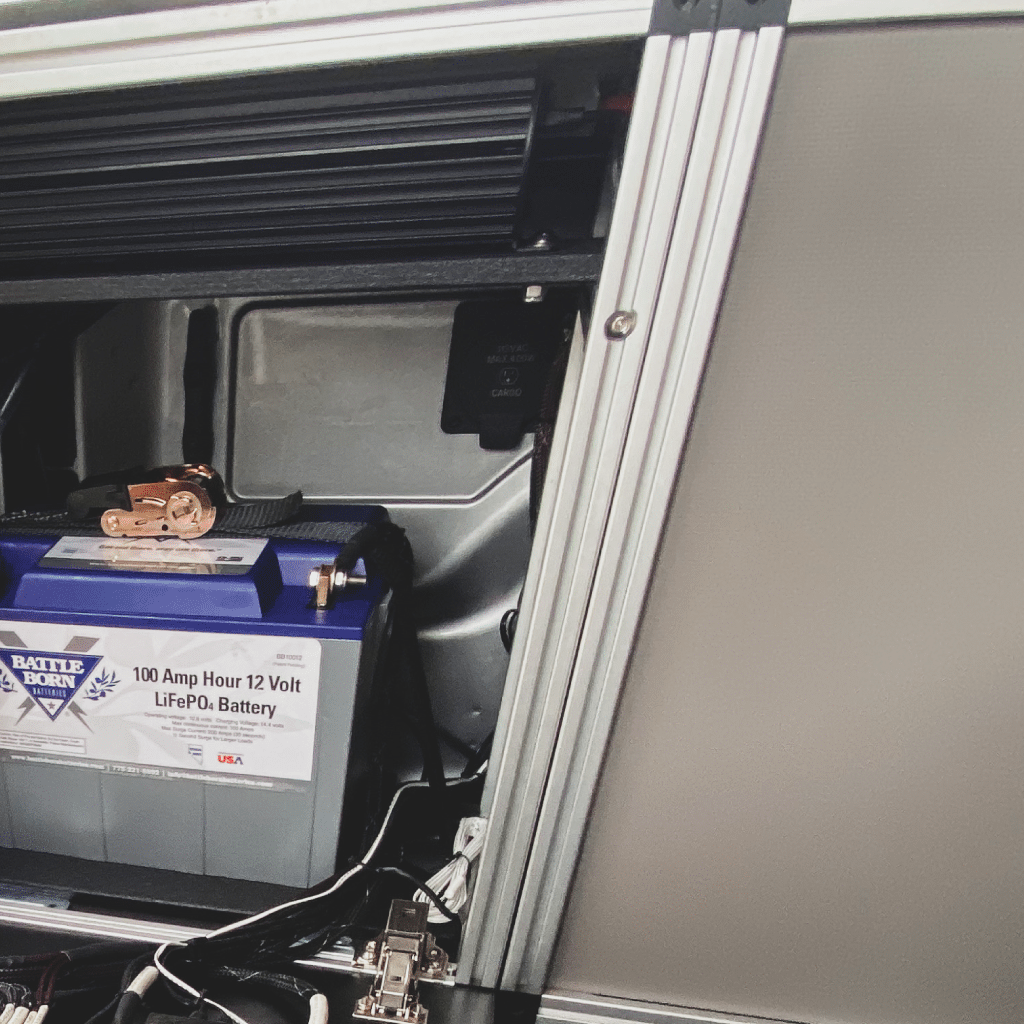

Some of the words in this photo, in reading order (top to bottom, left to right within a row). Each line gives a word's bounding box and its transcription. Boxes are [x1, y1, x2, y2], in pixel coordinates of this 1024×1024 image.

[491, 388, 523, 398] CARGO
[11, 655, 85, 674] BATTLE
[22, 671, 76, 689] BORN
[133, 666, 158, 683] 100
[162, 668, 198, 689] Amp
[203, 671, 242, 688] Hour
[246, 674, 264, 690] 12
[268, 675, 301, 693] Volt
[218, 696, 276, 719] Battery
[218, 755, 244, 765] USA
